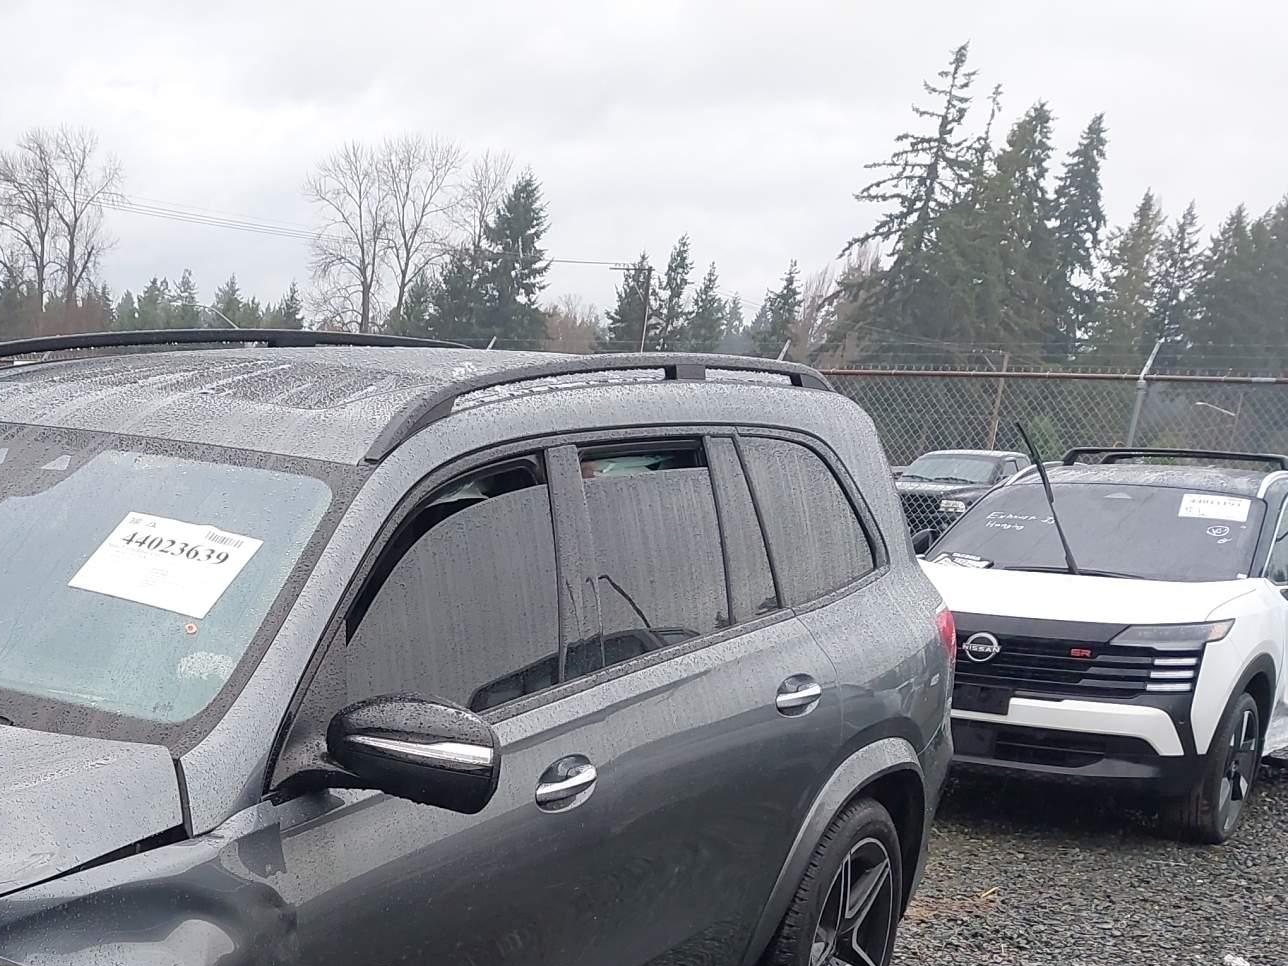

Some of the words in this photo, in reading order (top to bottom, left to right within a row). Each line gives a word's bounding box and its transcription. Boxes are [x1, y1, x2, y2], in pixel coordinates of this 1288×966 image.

[122, 531, 229, 564] 44023639
[962, 643, 1001, 654] NISSAN
[1070, 648, 1092, 658] SR
